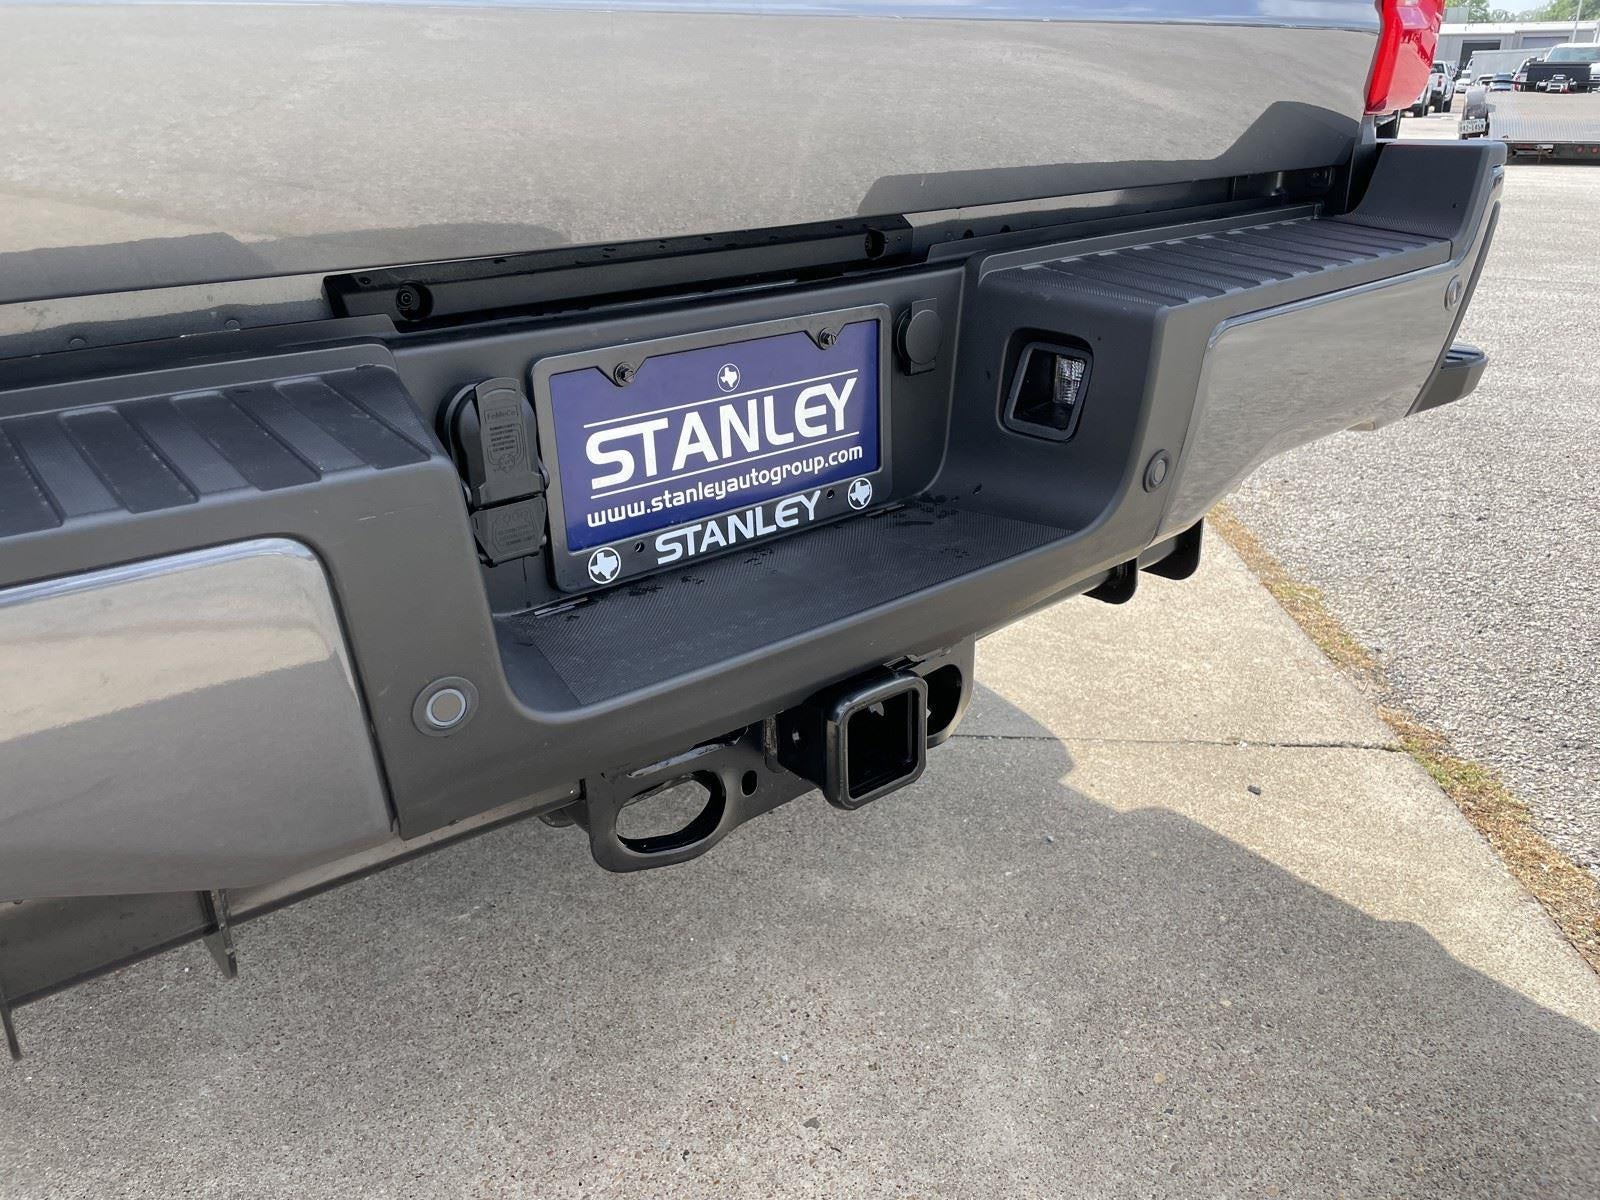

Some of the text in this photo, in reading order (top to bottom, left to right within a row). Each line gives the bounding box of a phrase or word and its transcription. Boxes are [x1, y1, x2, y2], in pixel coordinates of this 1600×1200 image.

[585, 376, 858, 491] STANLEY
[586, 445, 863, 528] www.stanleyautogroup.com
[654, 489, 822, 565] STANLEY
